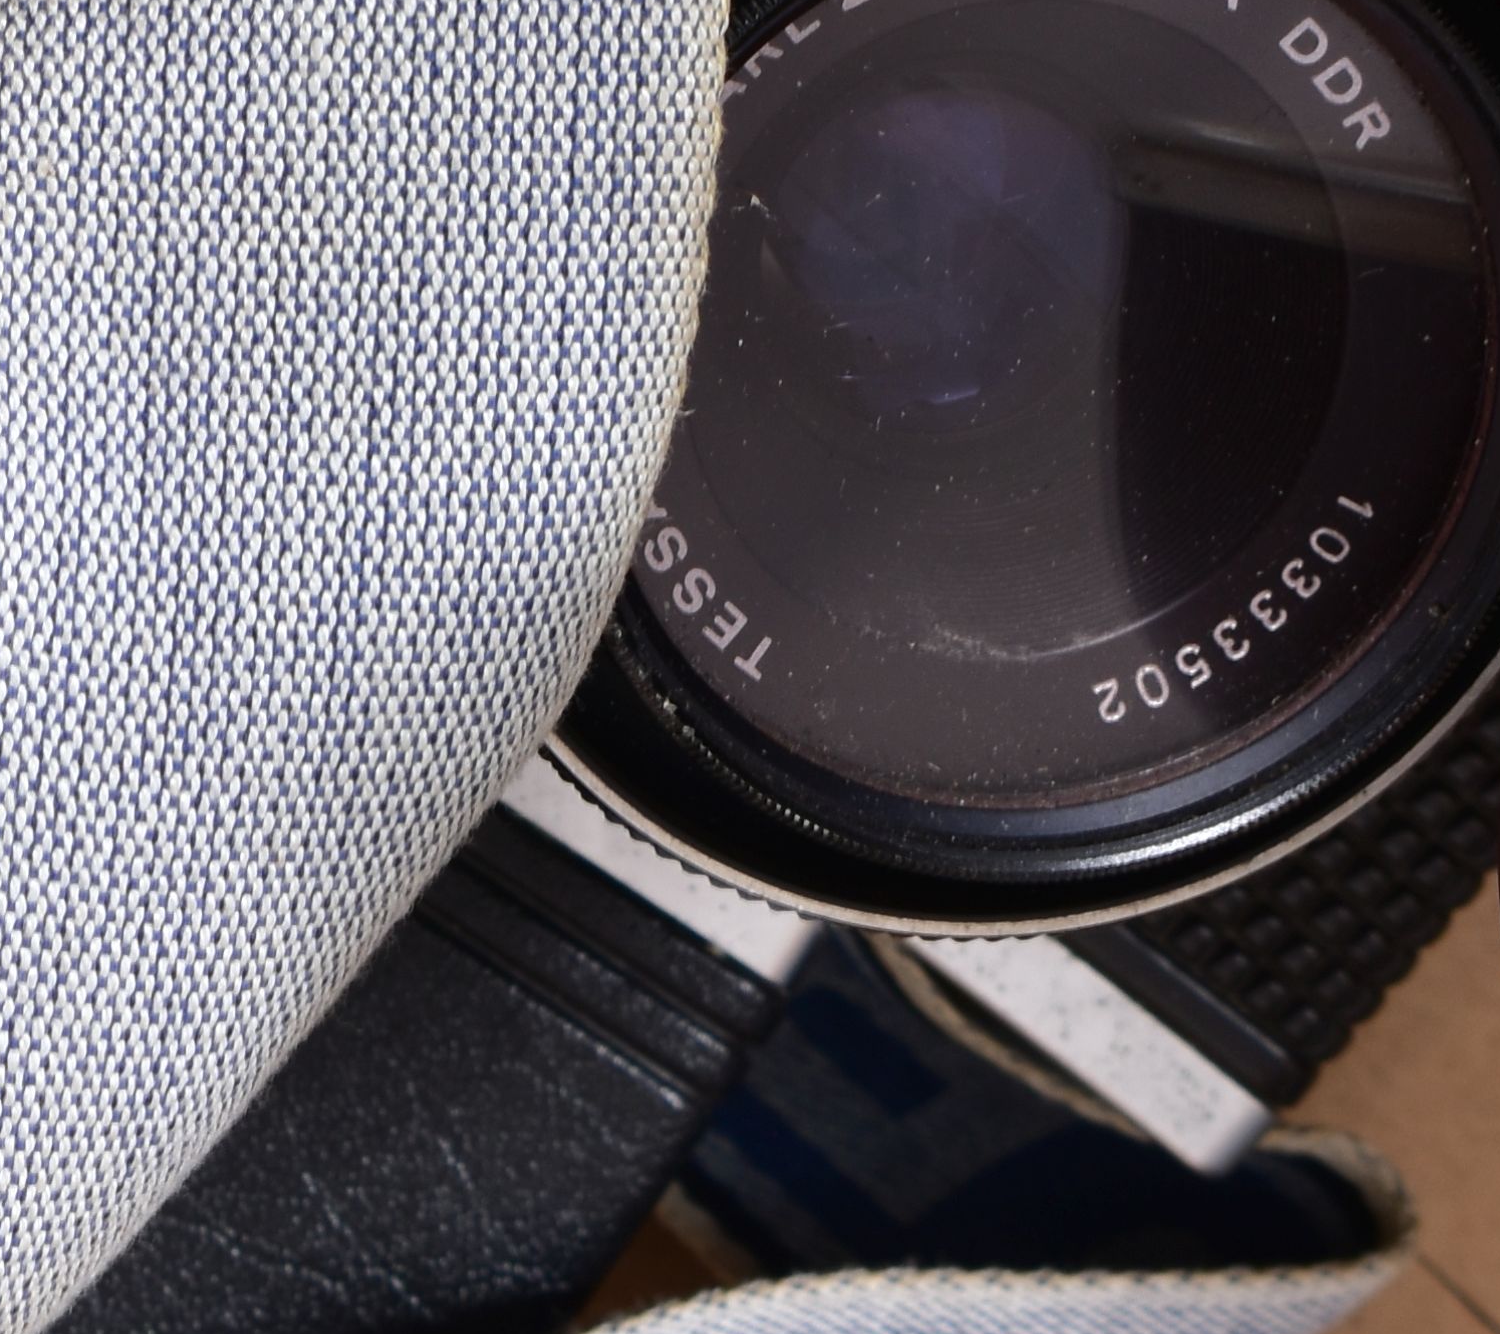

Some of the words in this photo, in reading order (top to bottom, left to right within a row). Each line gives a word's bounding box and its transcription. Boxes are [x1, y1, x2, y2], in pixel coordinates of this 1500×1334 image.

[1278, 14, 1395, 151] DDR
[644, 498, 774, 683] TESS
[1092, 495, 1376, 724] 10333502
